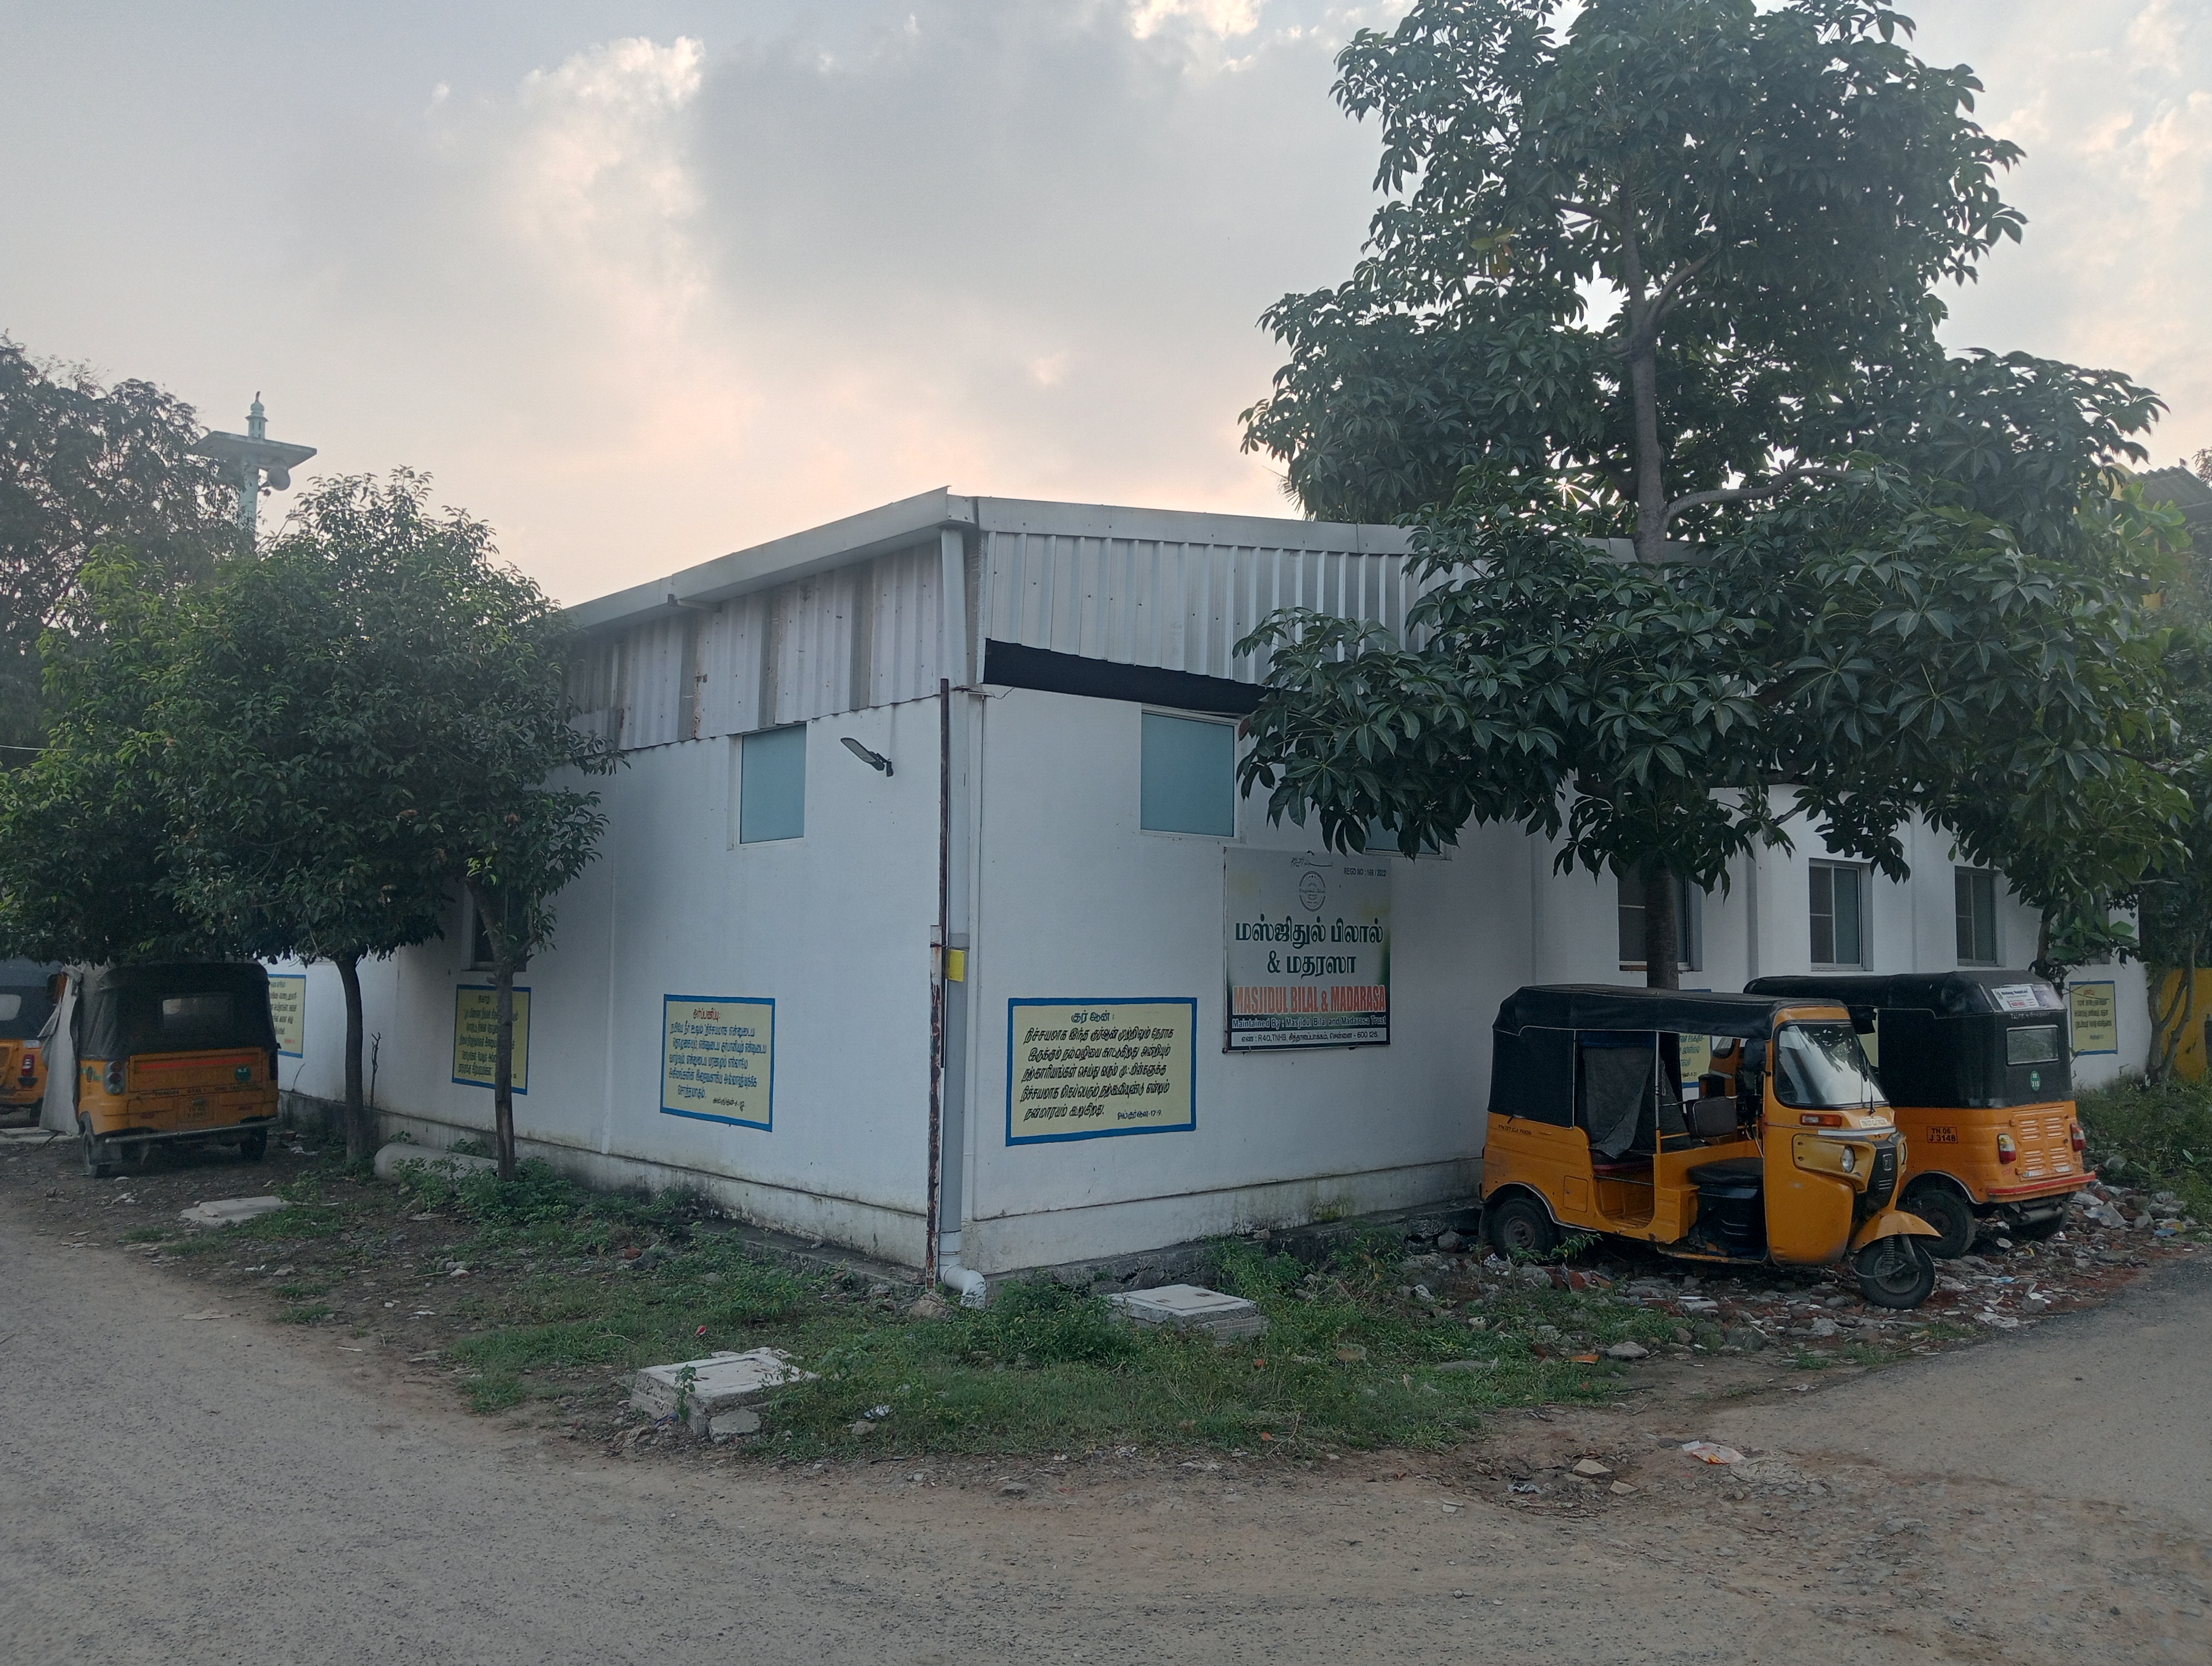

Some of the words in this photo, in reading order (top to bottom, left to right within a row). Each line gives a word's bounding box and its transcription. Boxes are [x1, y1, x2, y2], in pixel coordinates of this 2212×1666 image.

[1235, 913, 1326, 949] மஸ்ஜிதுல்
[1331, 917, 1383, 943] பிலால்
[1268, 950, 1281, 974] &
[1286, 955, 1356, 979] மதரஸா
[1233, 986, 1288, 1015] MASJIDUL
[1290, 986, 1319, 1014] BILAL
[1321, 989, 1328, 1013] &
[1330, 985, 1386, 1013] MADARASA
[1232, 1017, 1270, 1029] Maintained
[1271, 1018, 1281, 1030] By
[1286, 1018, 1311, 1029] Masjidul
[1313, 1017, 1327, 1026] Bilal
[1328, 1017, 1339, 1026] and
[1340, 1016, 1369, 1026] Madarasa
[1371, 1015, 1386, 1025] Trust
[1023, 1028, 1067, 1045] நிச்சயமாக
[1069, 1027, 1089, 1042] இந்த
[1151, 1028, 1174, 1041] நேராக
[1020, 1085, 1059, 1103] நிச்சயமாக
